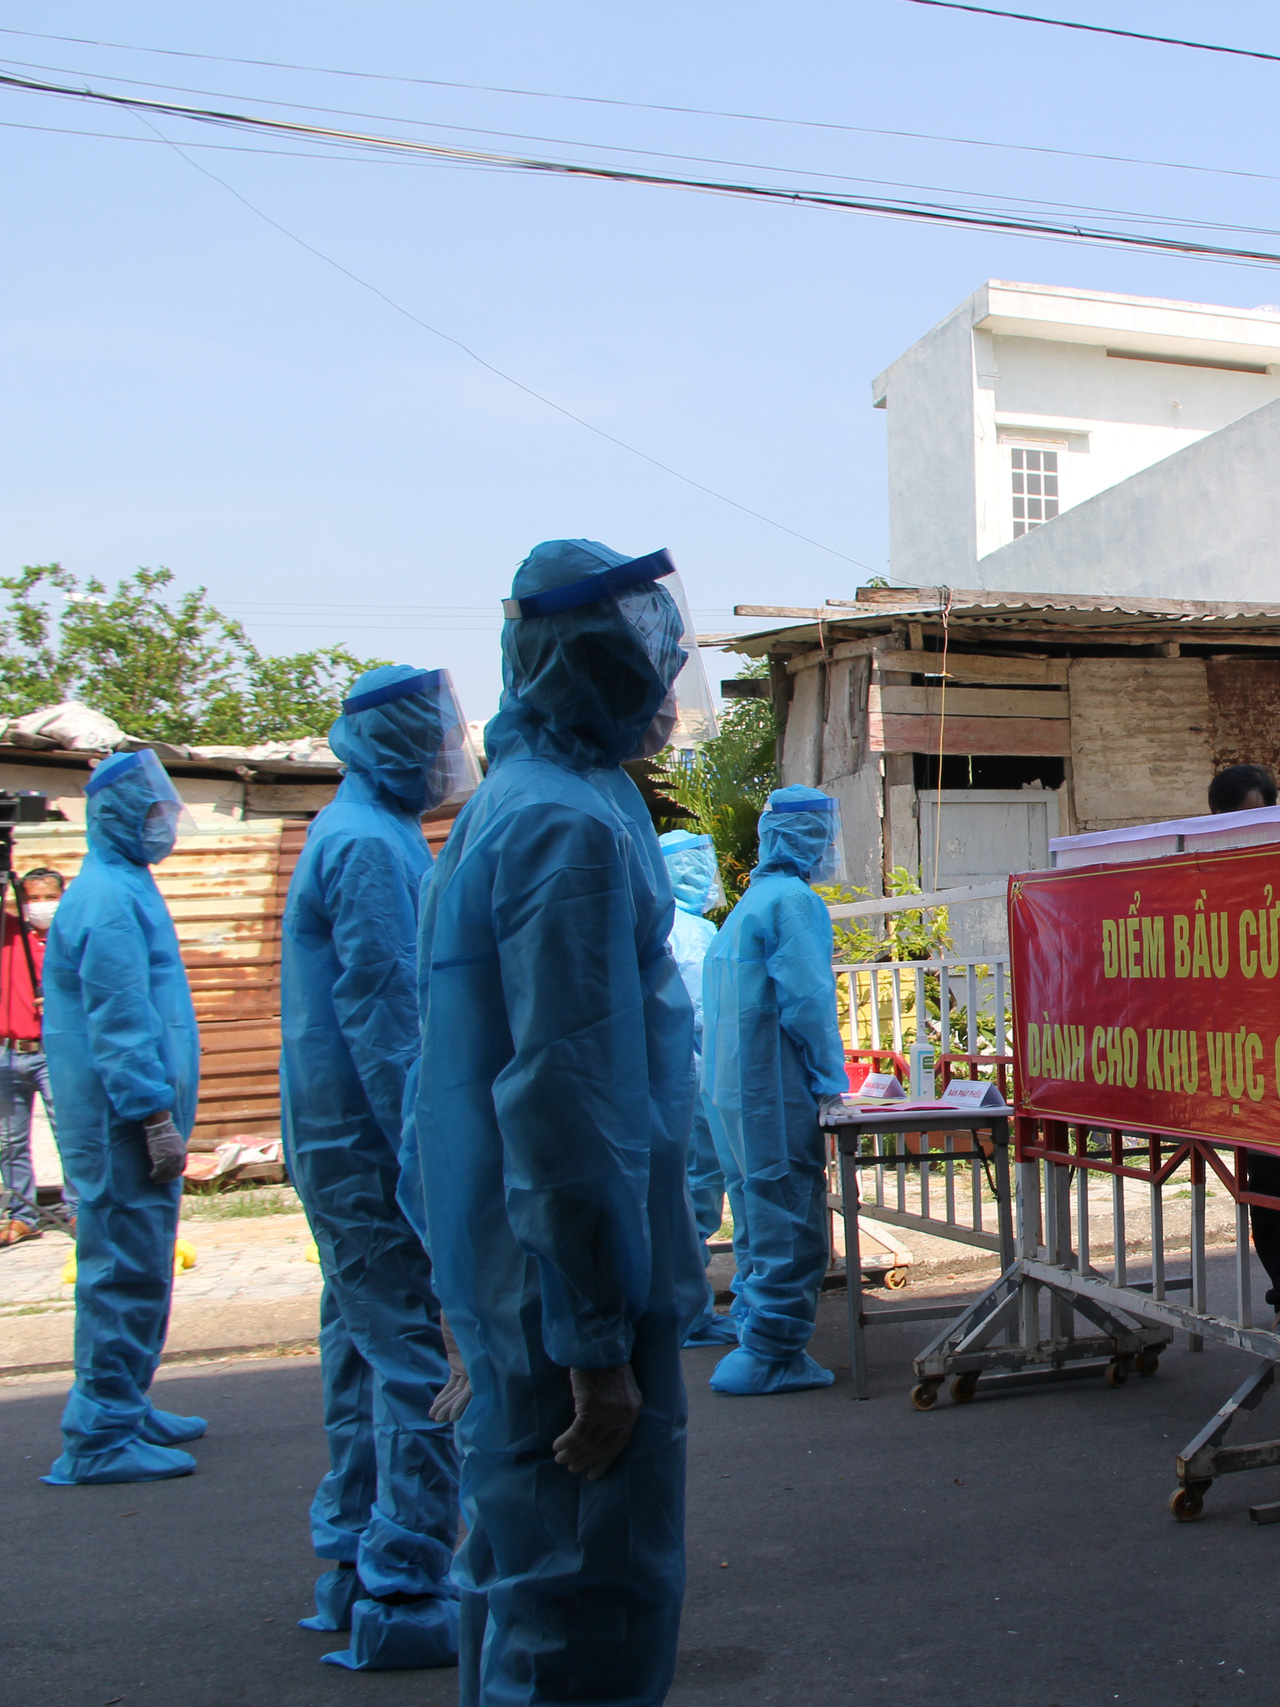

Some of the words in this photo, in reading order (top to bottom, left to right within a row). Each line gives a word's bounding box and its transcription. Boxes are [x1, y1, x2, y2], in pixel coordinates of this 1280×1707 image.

[1102, 891, 1166, 979] ĐIỂM
[1173, 889, 1229, 979] BẦU
[1027, 1011, 1086, 1083] DÀNH
[1092, 1024, 1139, 1089] CHO
[1146, 1027, 1200, 1096] KHU
[1206, 1024, 1265, 1115] VỰC
